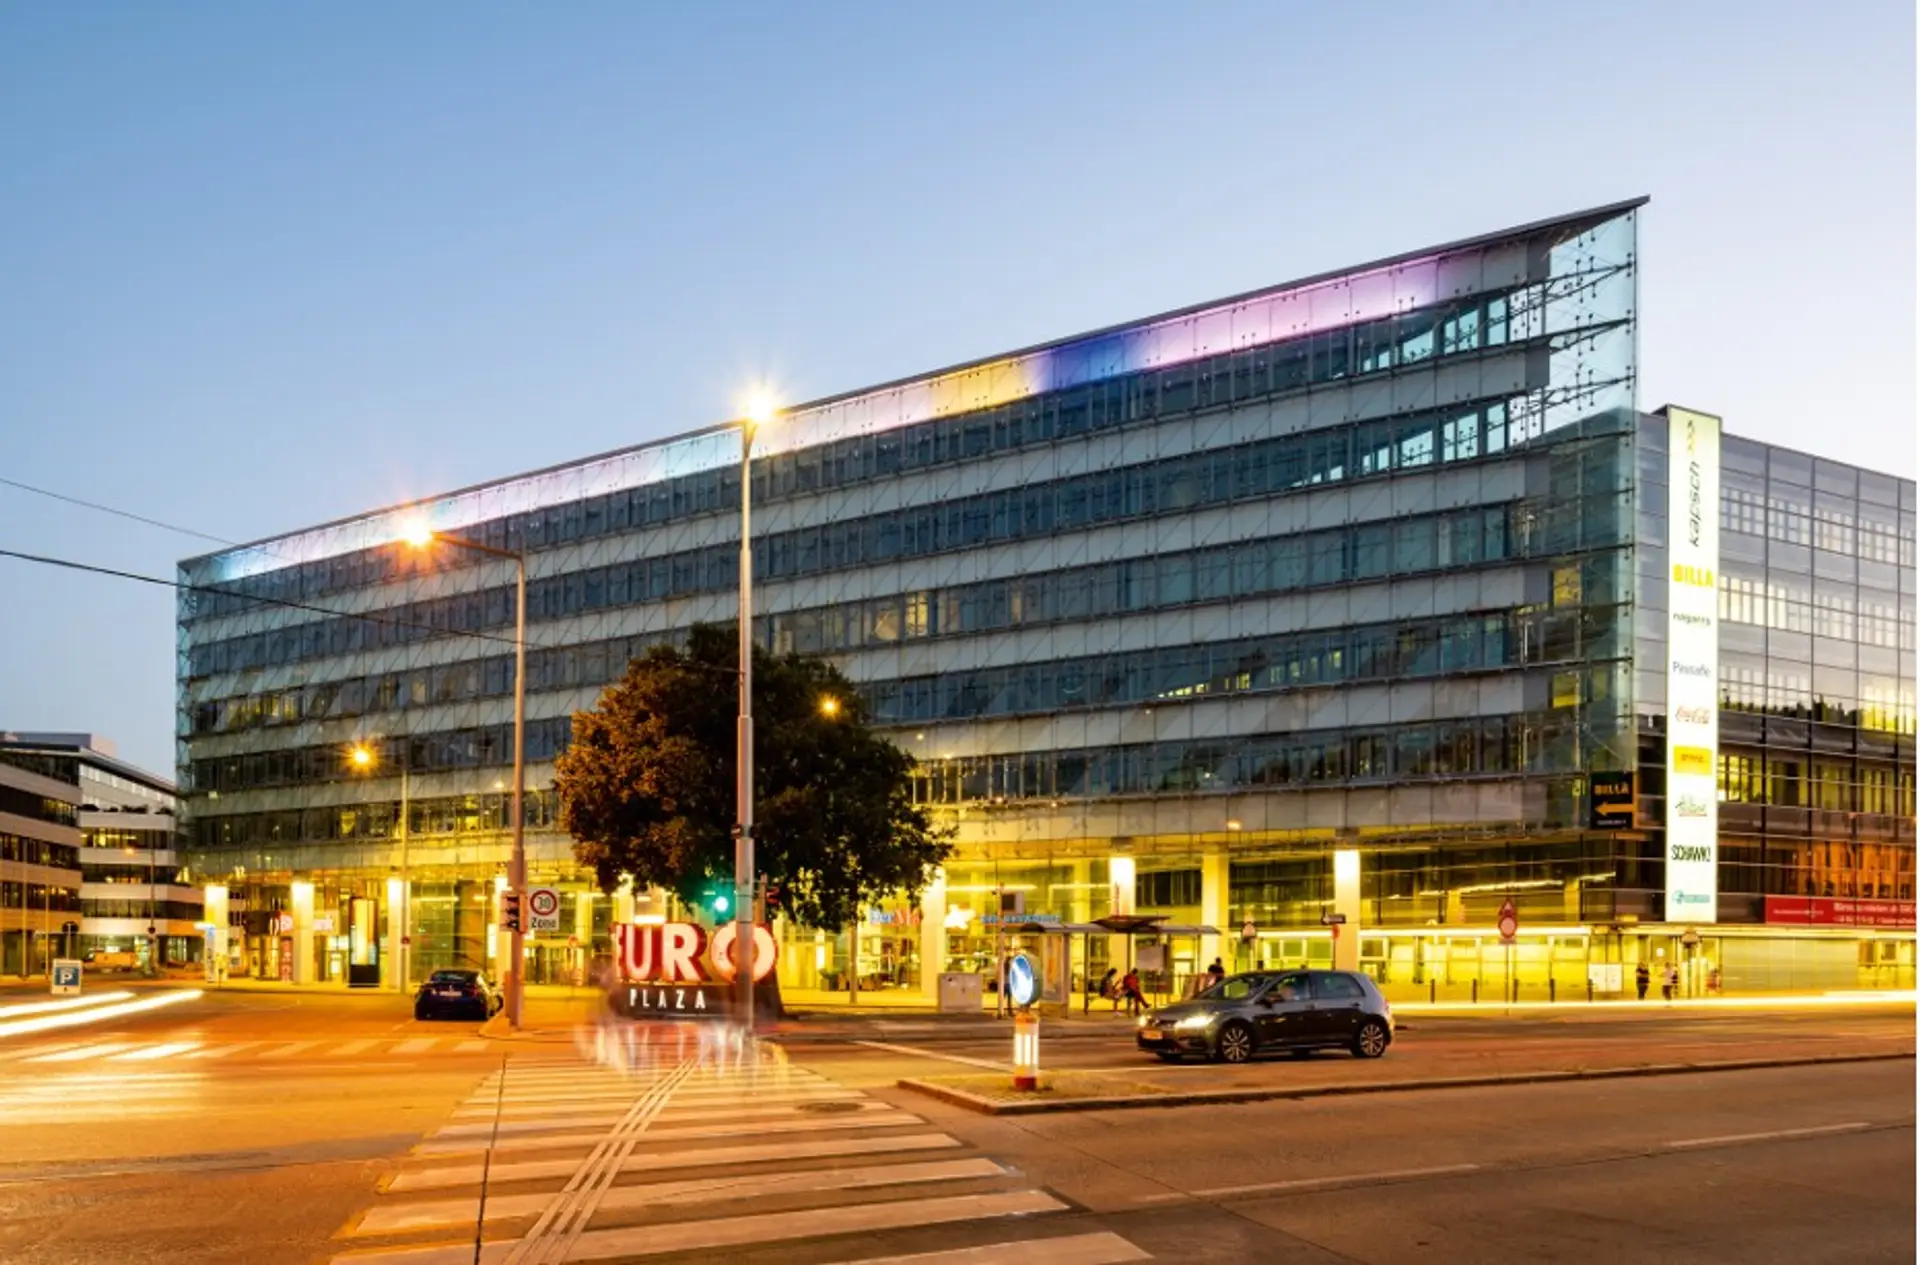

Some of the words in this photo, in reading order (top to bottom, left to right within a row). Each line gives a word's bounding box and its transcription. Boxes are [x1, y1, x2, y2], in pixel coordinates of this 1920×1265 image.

[1672, 564, 1715, 589] BILLA
[531, 916, 557, 928] Zone
[60, 968, 73, 984] P
[629, 988, 707, 1010] PLAZA
